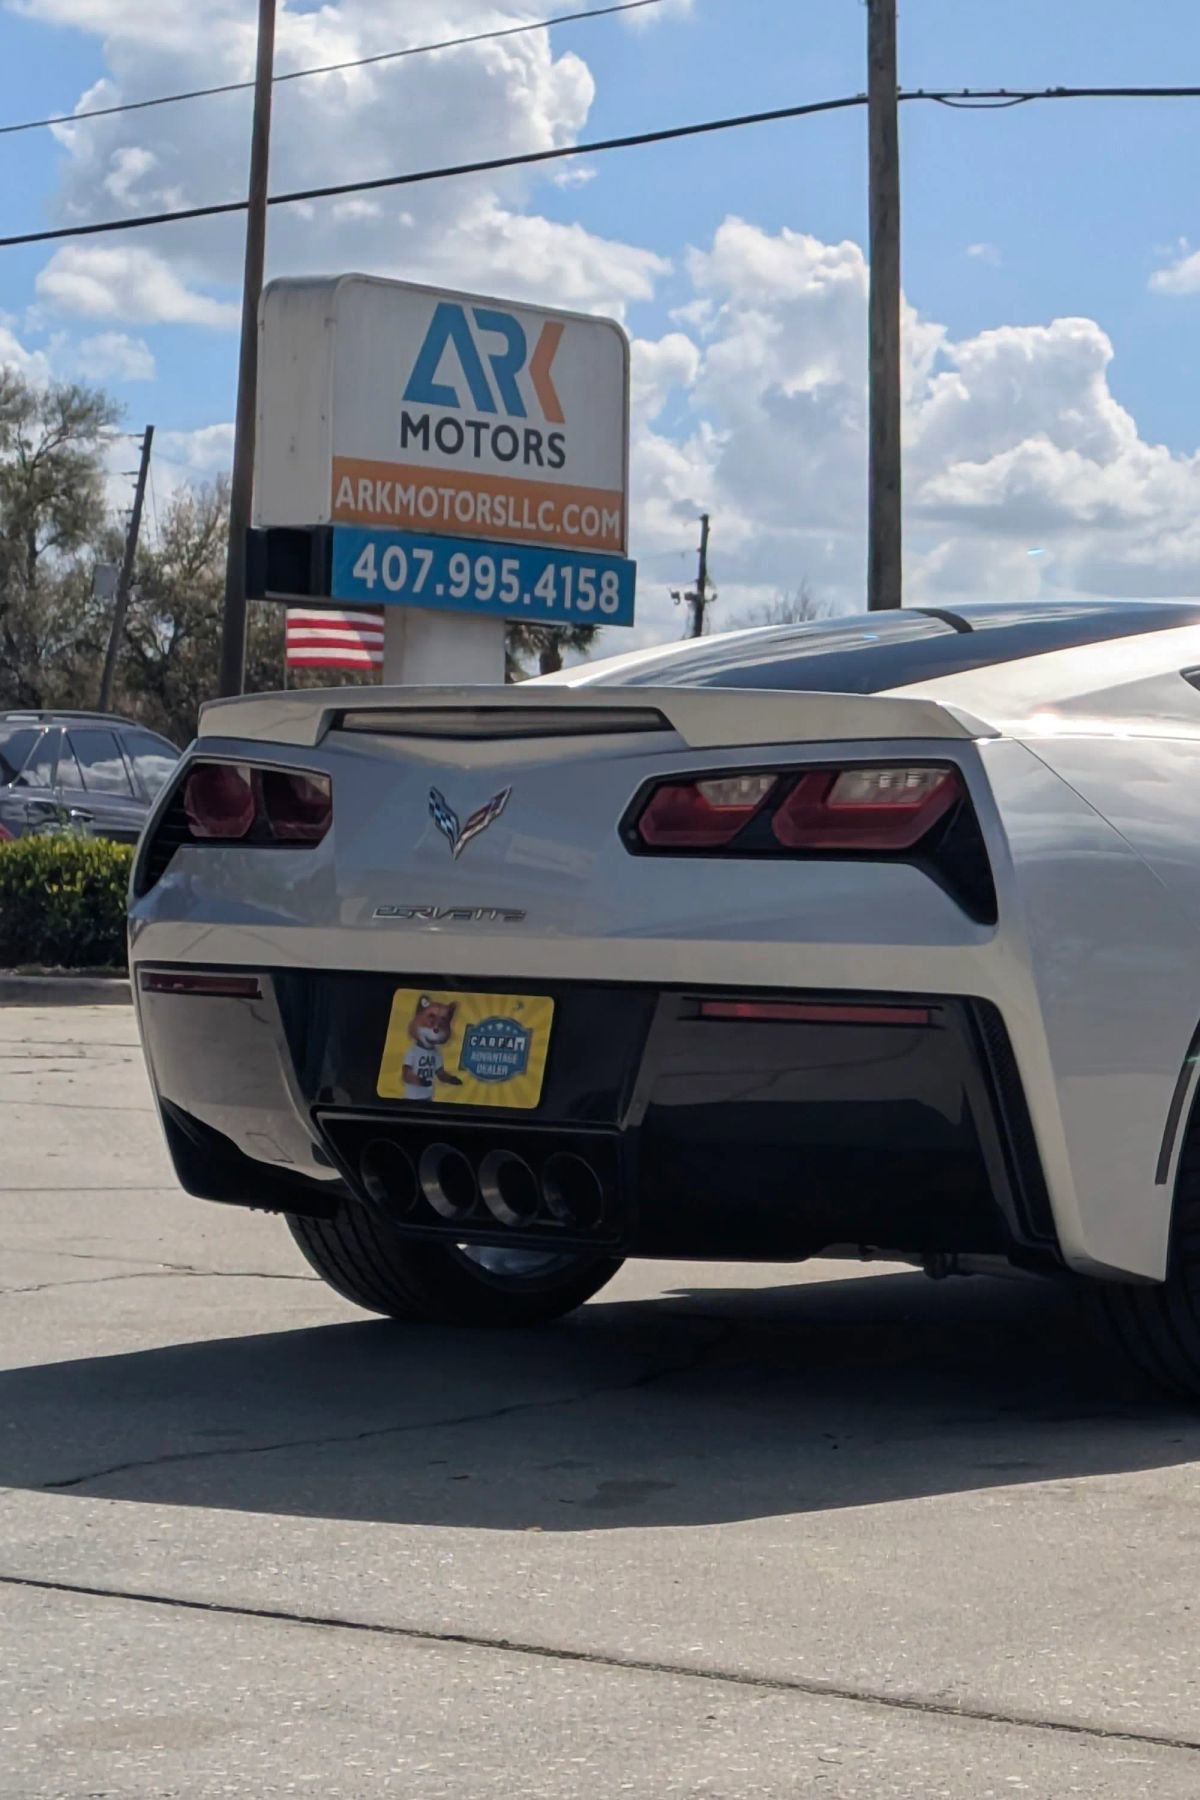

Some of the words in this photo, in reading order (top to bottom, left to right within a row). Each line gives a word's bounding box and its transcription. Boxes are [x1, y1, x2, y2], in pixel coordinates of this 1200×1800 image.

[402, 302, 565, 423] ARK
[401, 411, 566, 469] MOTORS
[335, 476, 620, 539] ARKMOTORSLLC.COM
[353, 543, 619, 613] 407.995.4158
